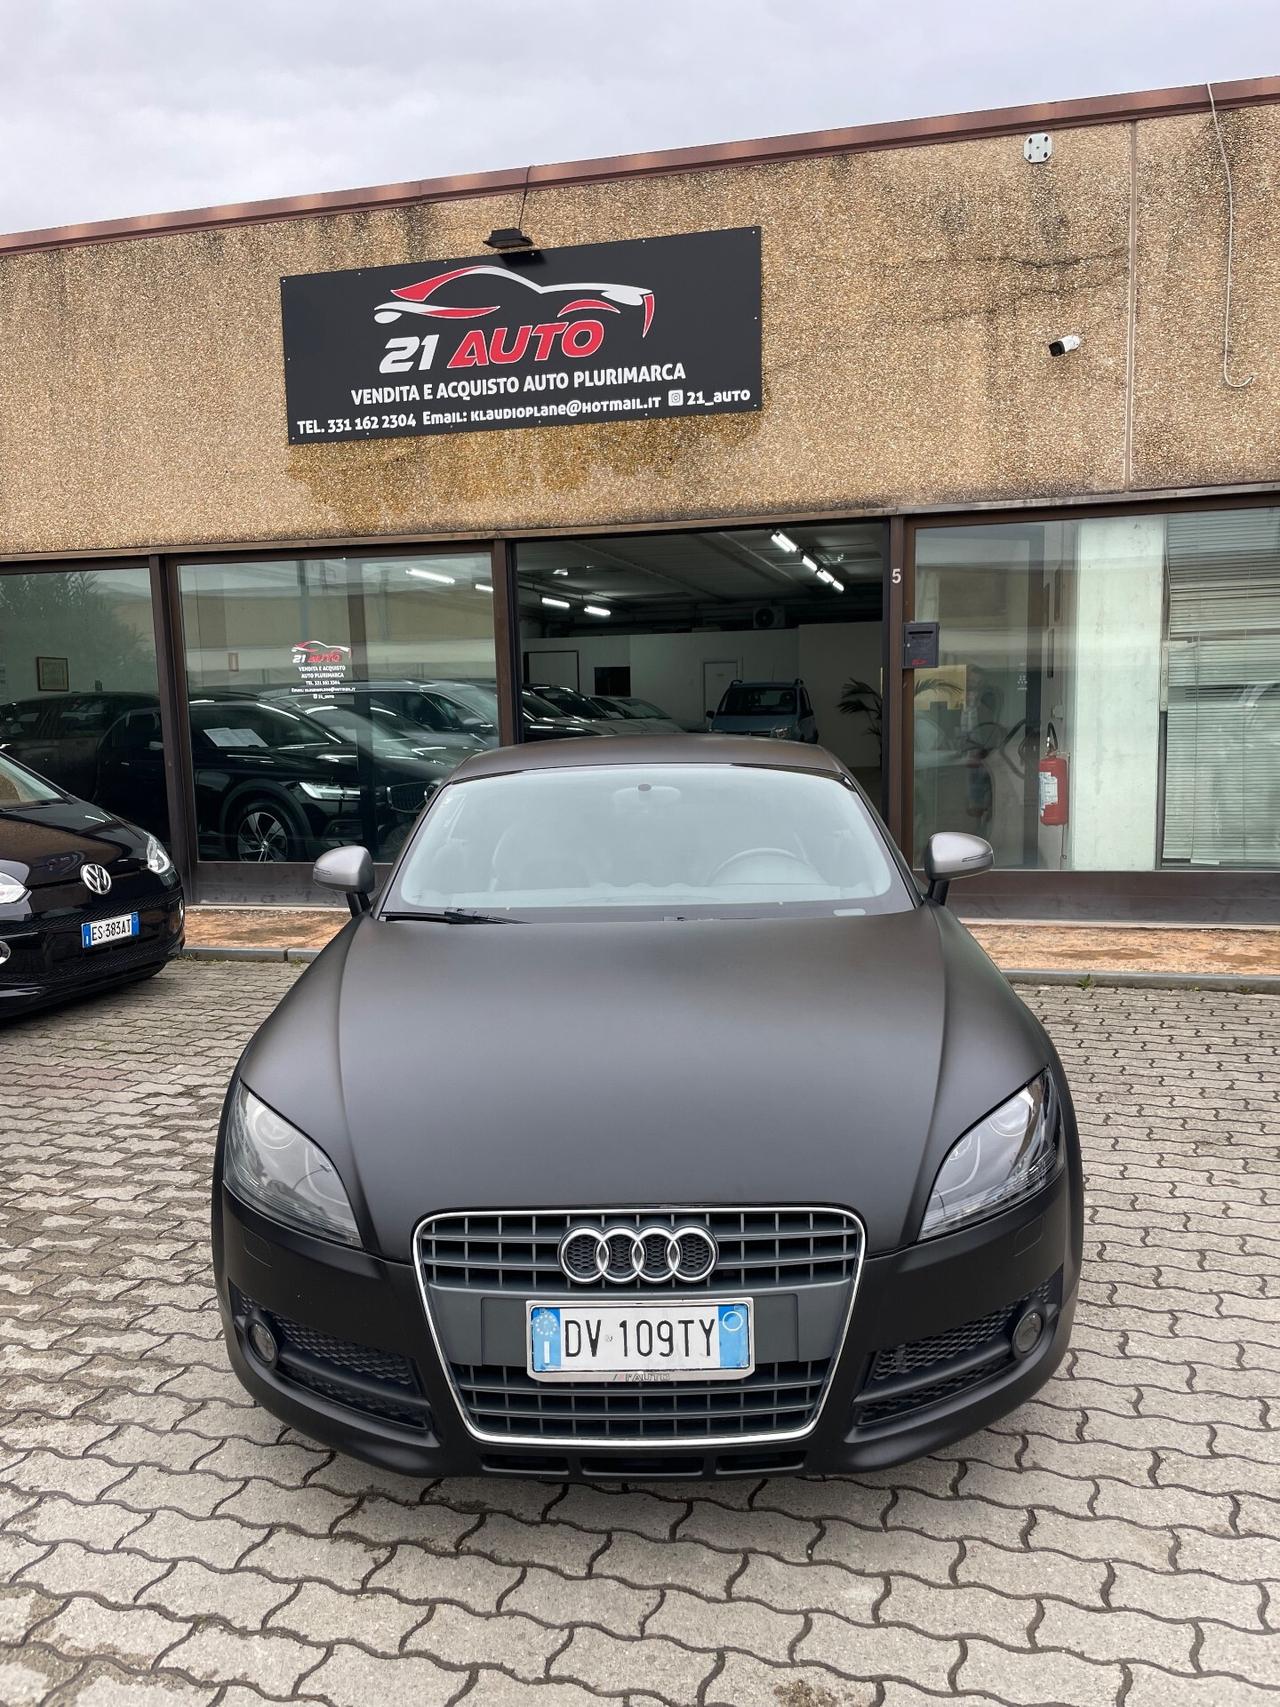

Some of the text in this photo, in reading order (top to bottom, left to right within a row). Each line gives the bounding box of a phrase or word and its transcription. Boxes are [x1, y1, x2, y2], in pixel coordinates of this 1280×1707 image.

[379, 320, 605, 374] 21 AUTO
[351, 362, 687, 405] VENDITA E ACQUISTO AUTO PLURIMARCA
[296, 419, 326, 435] TEL.
[327, 418, 353, 433] 331
[354, 415, 380, 431] 162
[381, 412, 417, 429] 2304
[892, 568, 901, 583] 5
[292, 654, 306, 663] 21
[91, 925, 103, 942] ES
[106, 919, 131, 937] 383AT
[564, 1319, 602, 1358] DV
[619, 1318, 716, 1358] 109TY
